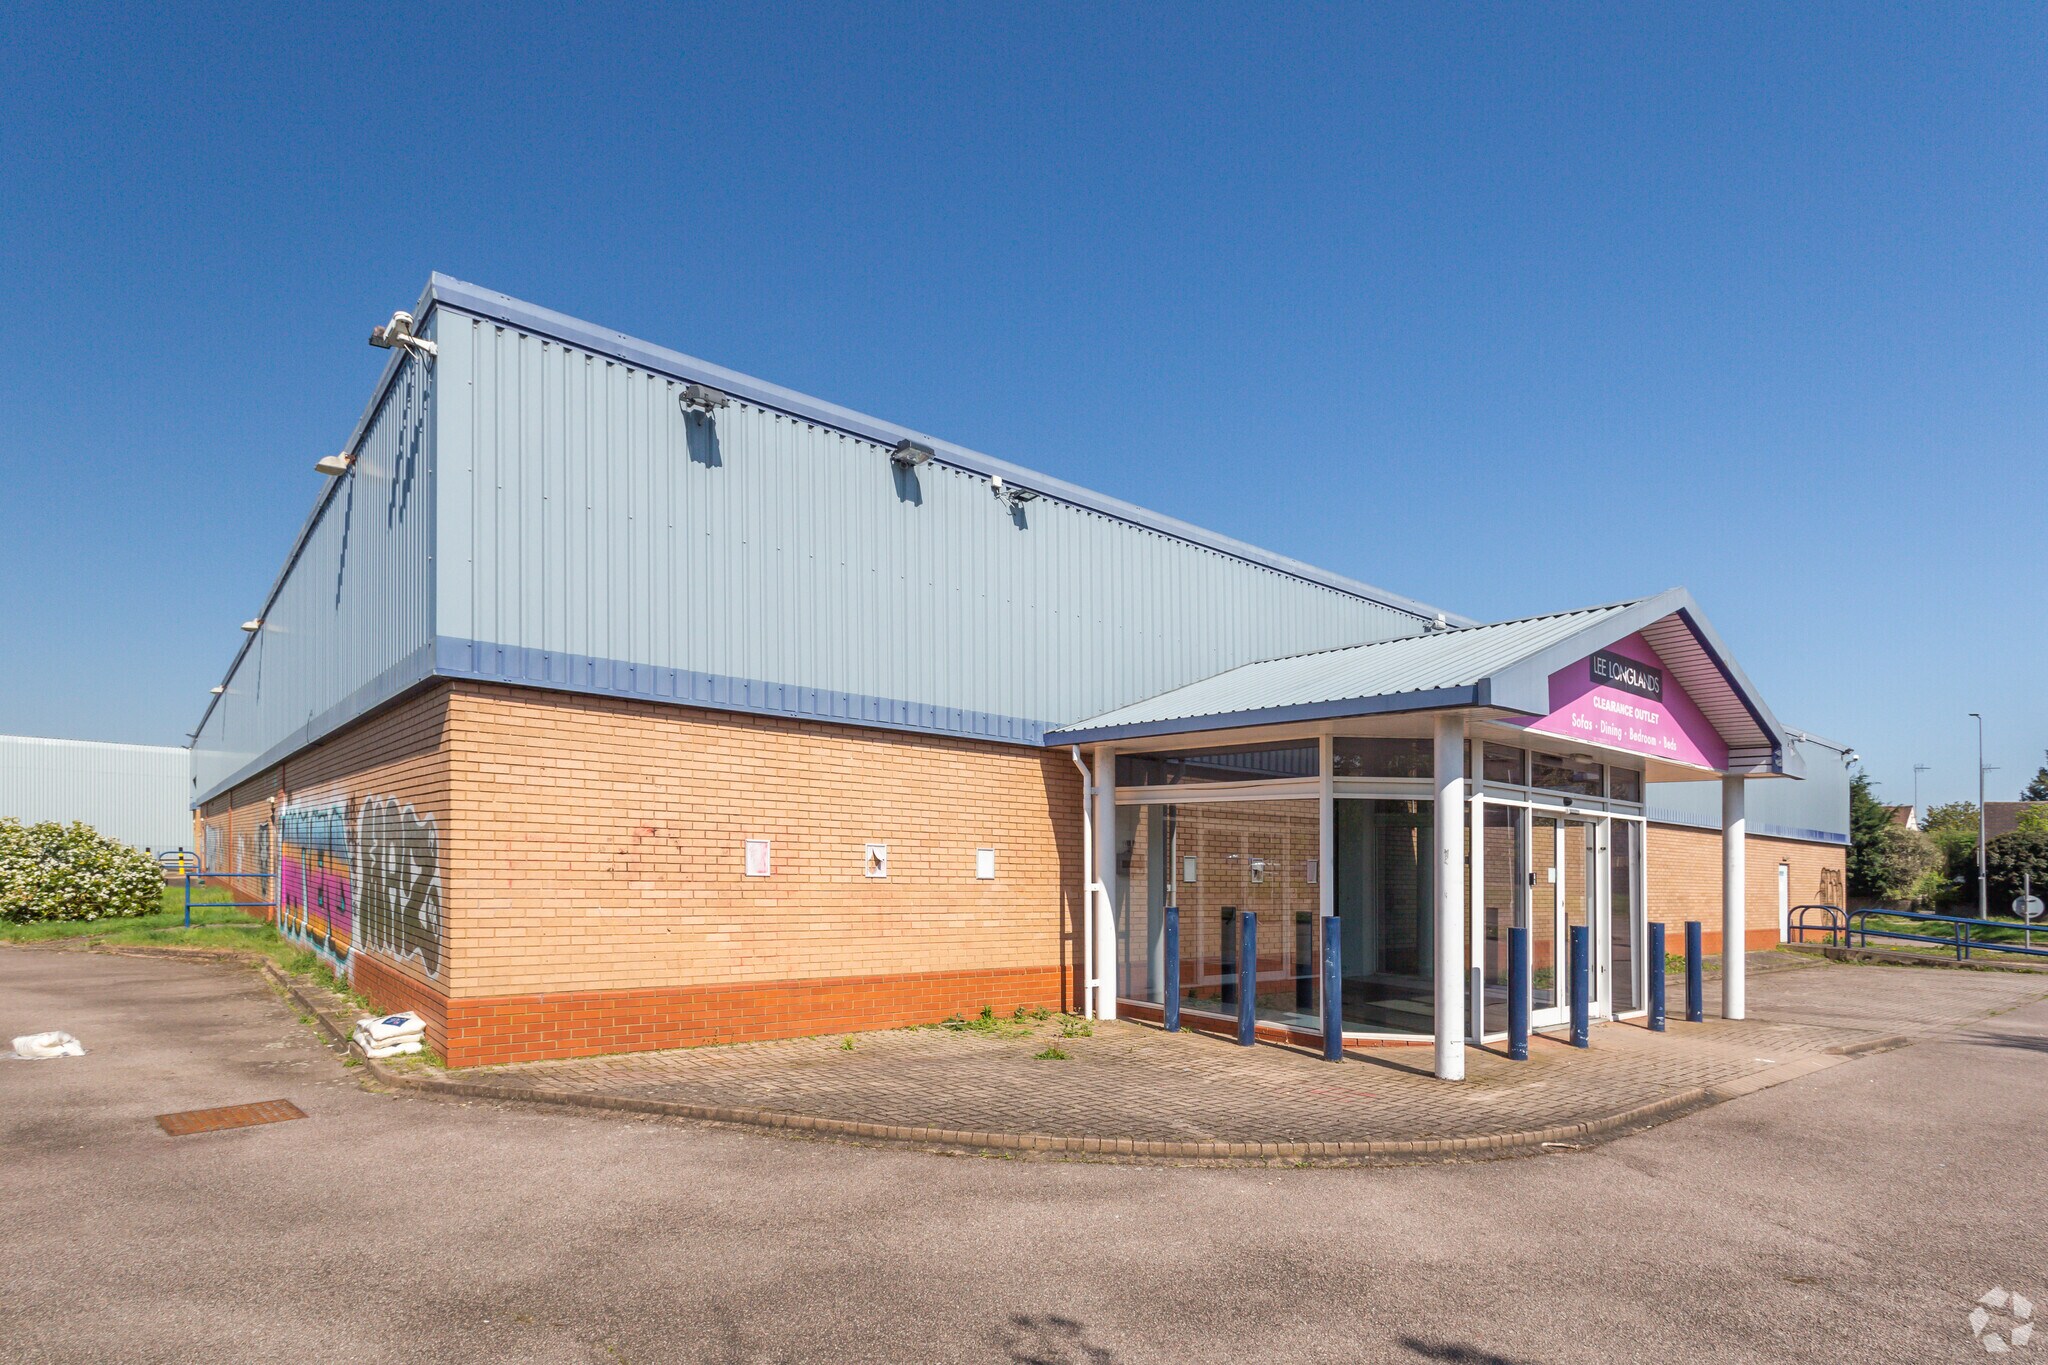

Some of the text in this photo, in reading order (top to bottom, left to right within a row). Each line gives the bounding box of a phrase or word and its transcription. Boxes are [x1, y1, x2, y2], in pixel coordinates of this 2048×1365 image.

[1593, 655, 1660, 693] LEE LONGLANDS
[1593, 696, 1659, 725] CLEARANCE OUTLET
[1571, 712, 1677, 751] Sofas Dining Bedroom Beds
